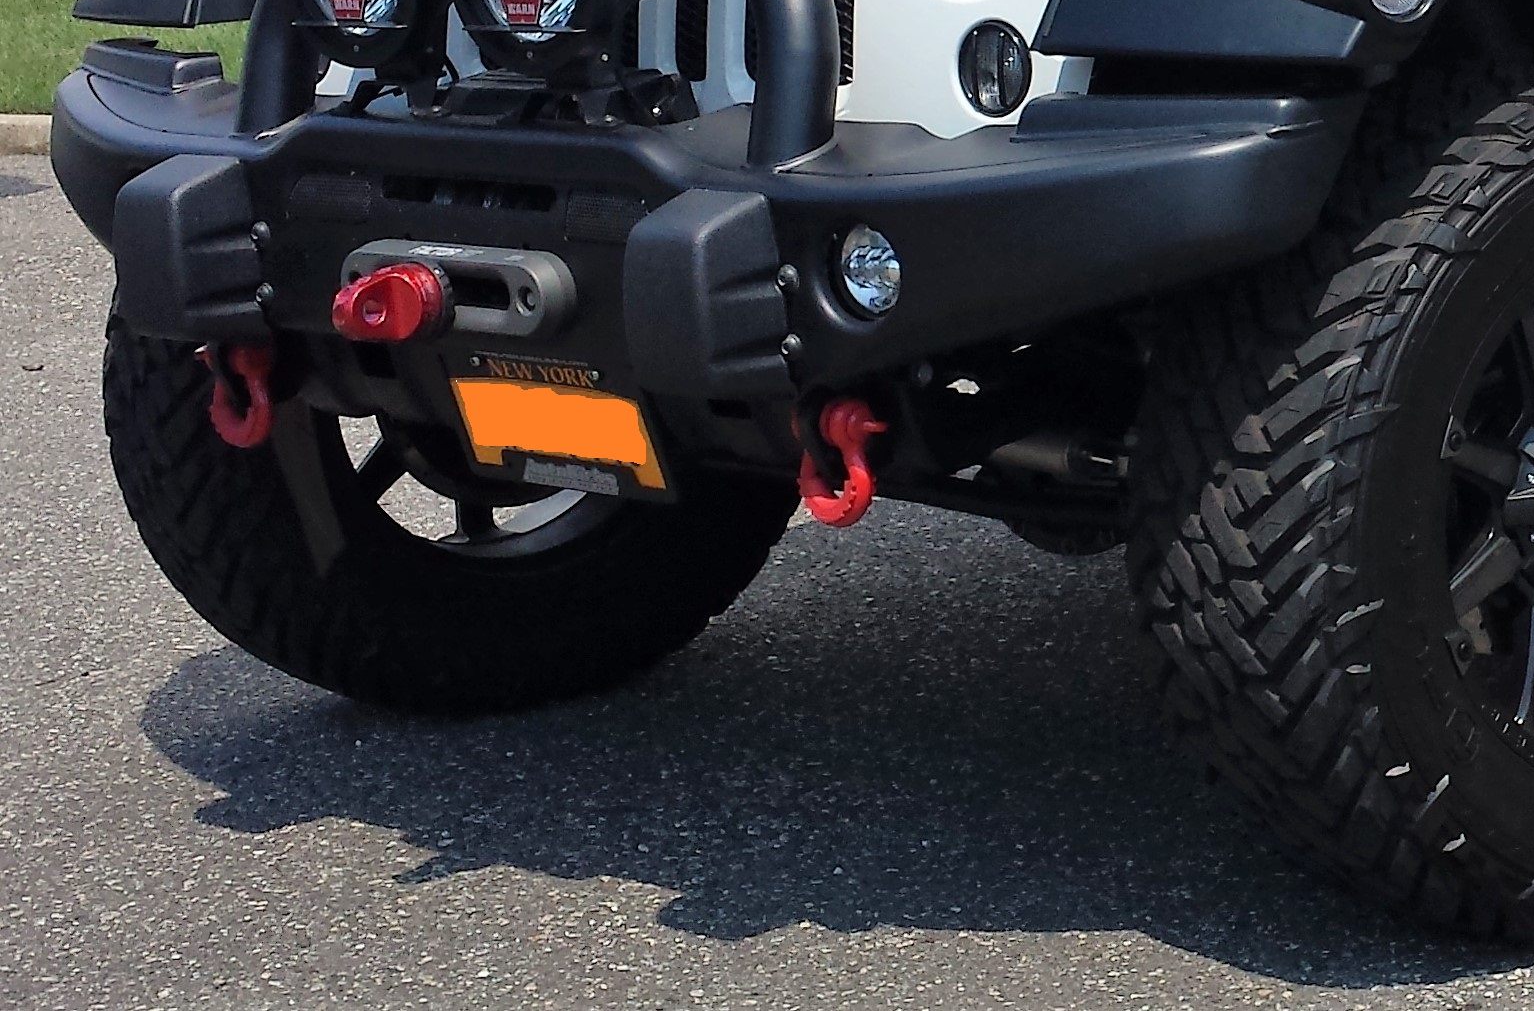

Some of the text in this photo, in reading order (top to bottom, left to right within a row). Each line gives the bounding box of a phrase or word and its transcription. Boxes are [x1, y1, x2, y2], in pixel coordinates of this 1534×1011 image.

[333, 0, 360, 11] WARN
[507, 3, 536, 15] WARN
[487, 358, 532, 380] NEW
[537, 365, 594, 388] YORK
